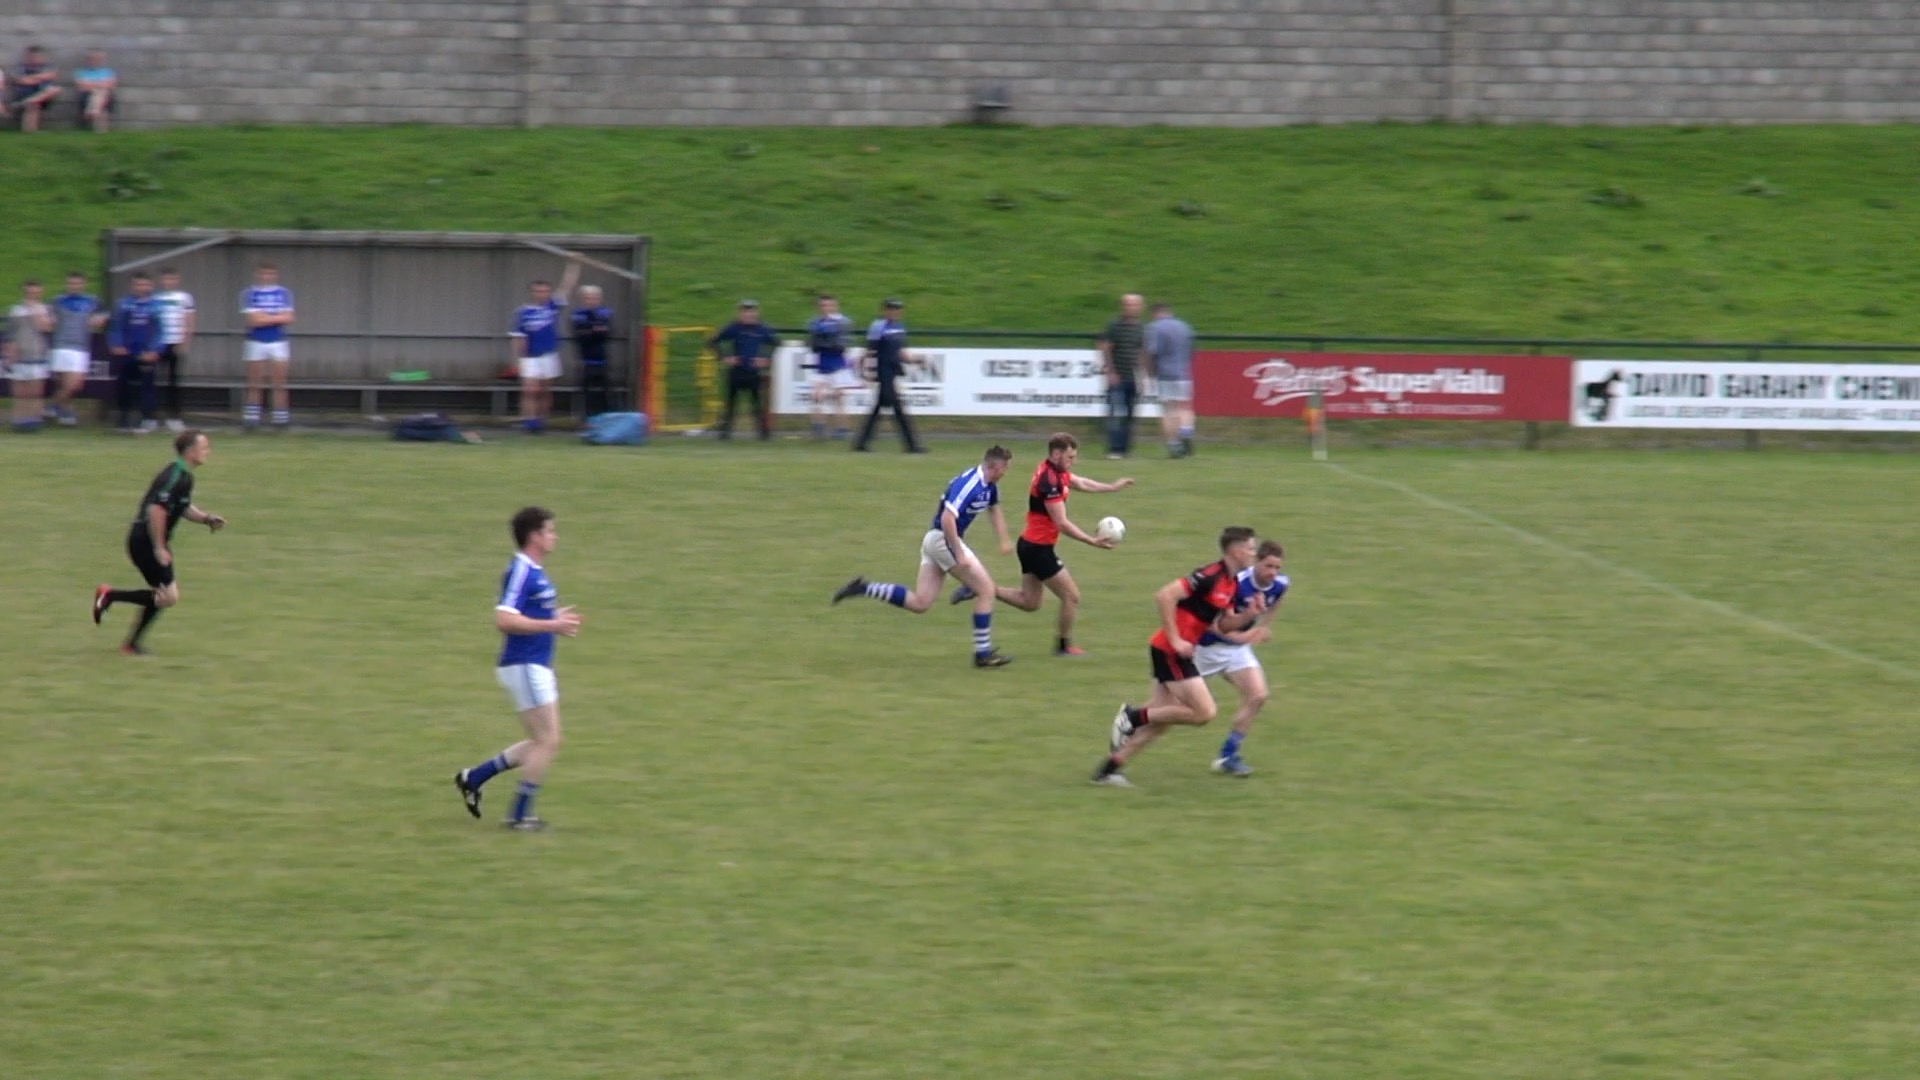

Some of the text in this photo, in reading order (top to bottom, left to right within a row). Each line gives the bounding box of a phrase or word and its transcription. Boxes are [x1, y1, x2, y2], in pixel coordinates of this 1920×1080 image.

[1350, 366, 1504, 401] SuperValu
[1628, 373, 1712, 398] DAVID
[1719, 374, 1829, 399] GARAHY
